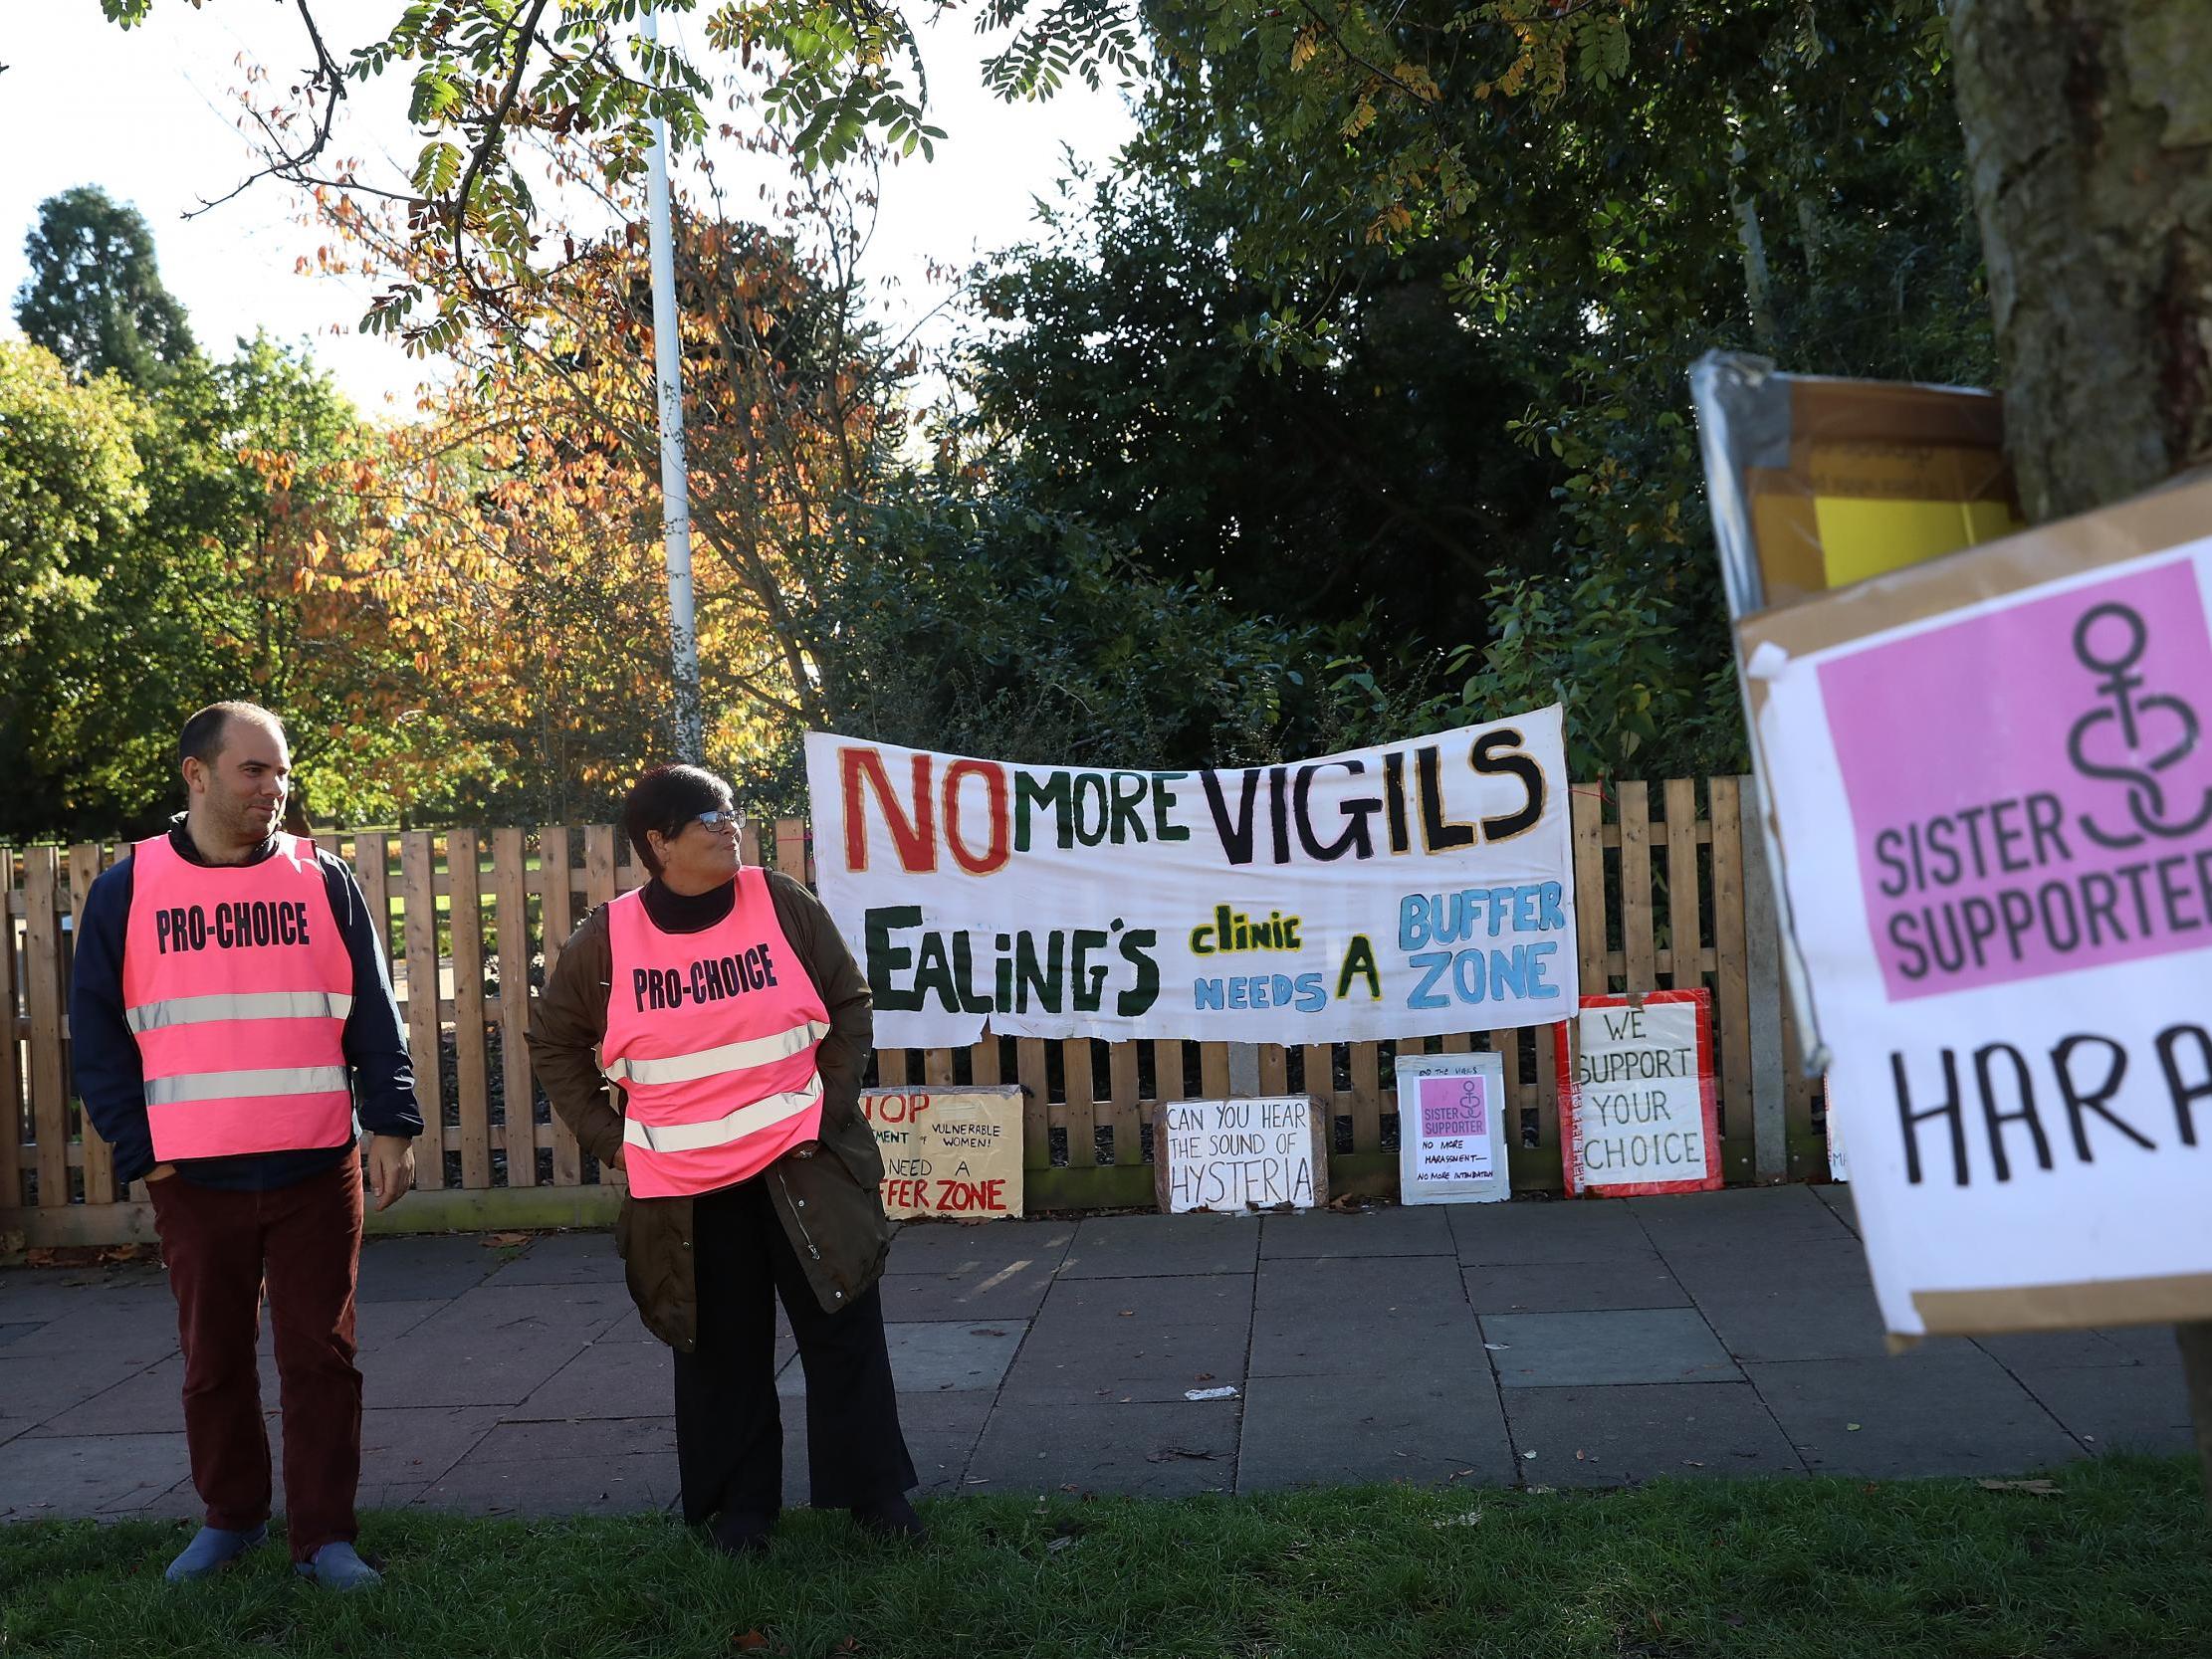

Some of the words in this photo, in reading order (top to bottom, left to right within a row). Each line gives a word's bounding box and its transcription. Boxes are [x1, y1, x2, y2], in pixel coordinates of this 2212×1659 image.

[838, 746, 1011, 877] NO
[1013, 770, 1191, 852] MORE
[1200, 727, 1549, 866] VIGILS
[1876, 793, 2073, 898] SISTER
[155, 902, 311, 954] PRO-CHOICE
[1399, 881, 1566, 951] BUFFER
[632, 942, 778, 1013] PRO-CHOICE
[1194, 972, 1328, 1013] NEEDS
[1334, 933, 1384, 1001] A
[1407, 941, 1561, 1010] ZONE
[1604, 1009, 1647, 1041] WE
[1580, 1048, 1692, 1086] SUPPORT
[1167, 1105, 1204, 1132] CAN
[1216, 1104, 1249, 1130] YOU
[1261, 1103, 1306, 1129] HEAR
[1425, 1108, 1458, 1121] SISTER
[1592, 1091, 1672, 1128] YOUR
[932, 1124, 1000, 1138] VULNERABLE
[943, 1138, 992, 1147] WOMEN!
[1169, 1137, 1202, 1159] THE
[1209, 1133, 1265, 1156] SOUND
[1275, 1132, 1297, 1154] OF
[1422, 1141, 1435, 1149] NO
[1425, 1121, 1483, 1135] SUPPORTER
[888, 1157, 933, 1177] NEED
[955, 1160, 971, 1177] A
[1584, 1133, 1701, 1170] CHOICE
[1170, 1157, 1312, 1203] HYSTERIA
[1417, 1172, 1430, 1181] NO
[936, 1178, 1007, 1211] ZONE
